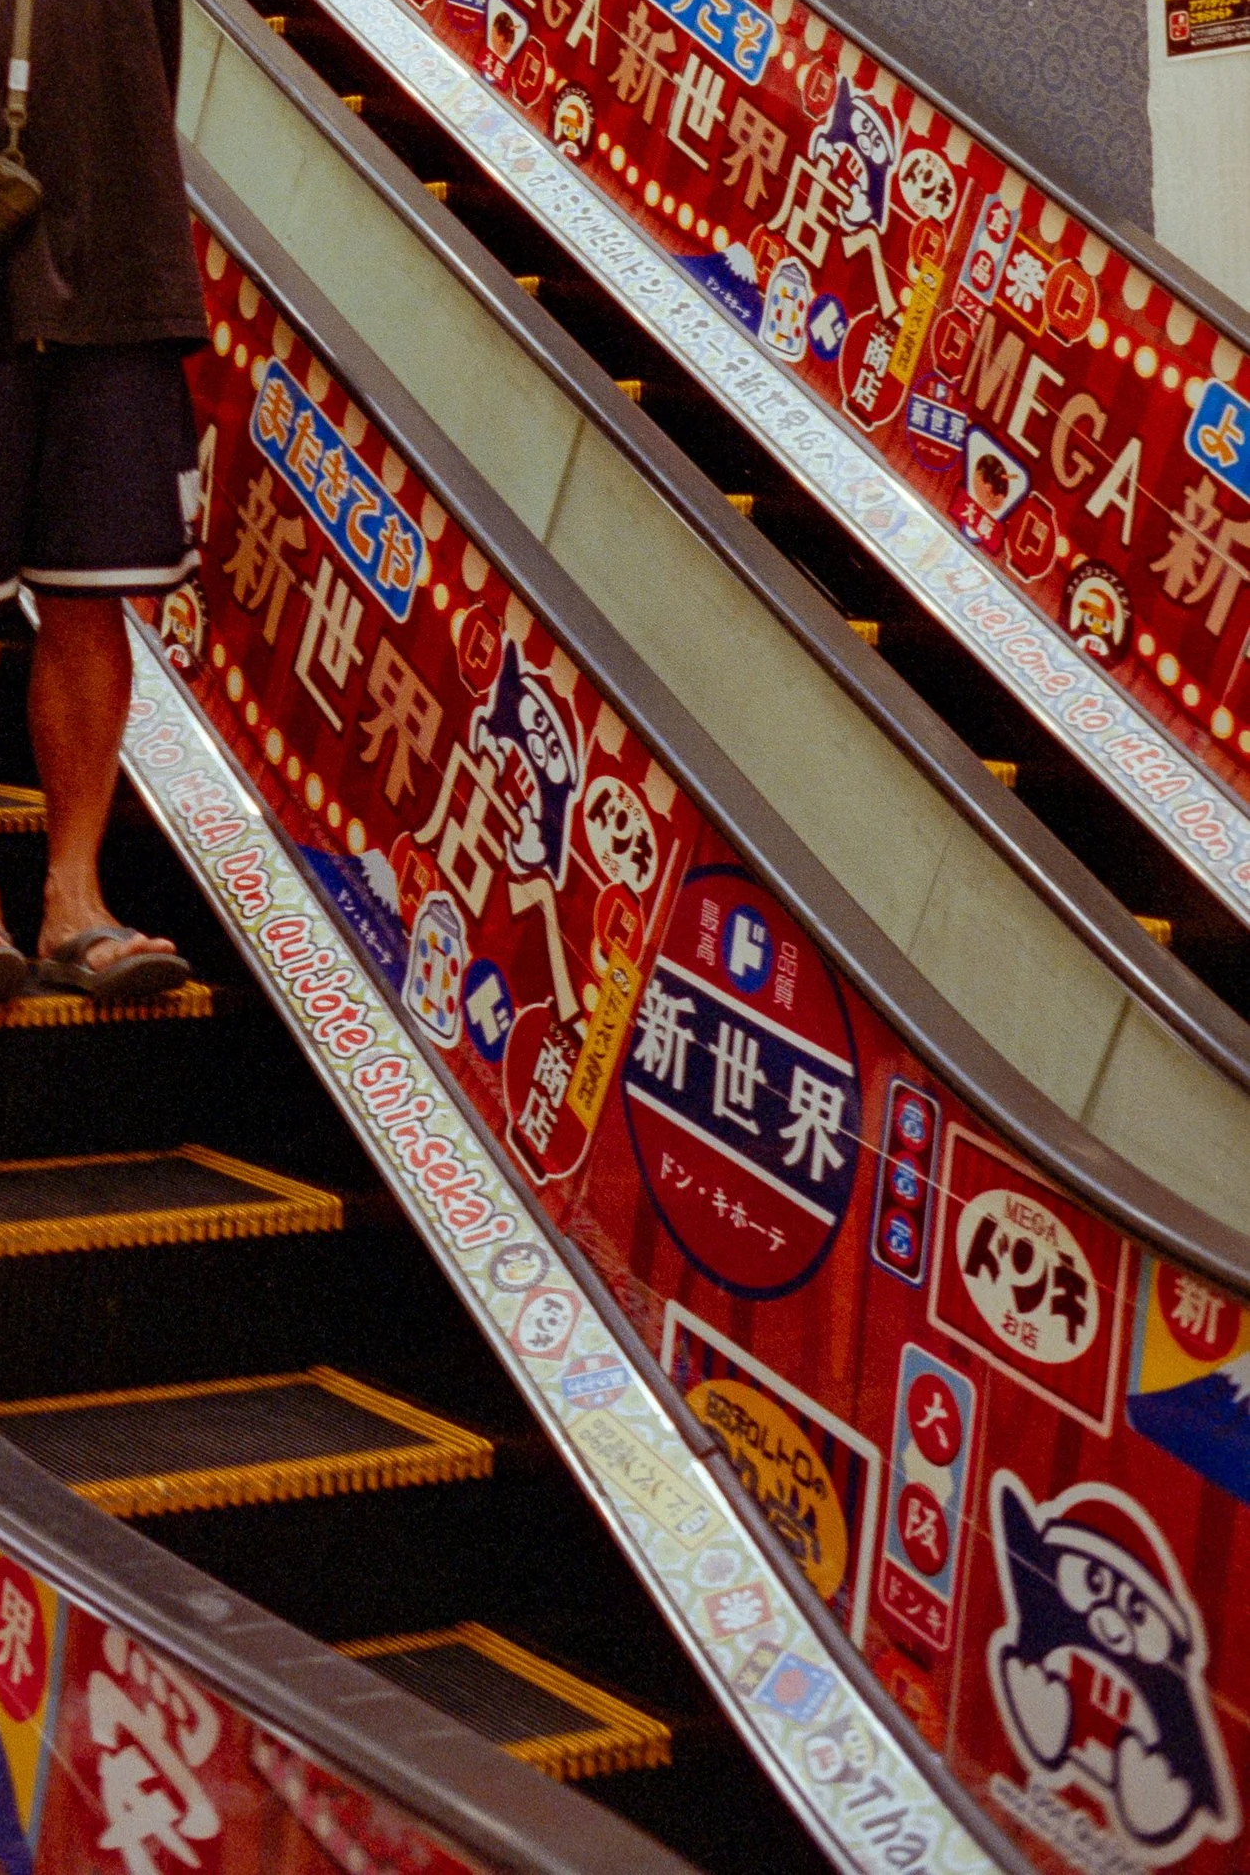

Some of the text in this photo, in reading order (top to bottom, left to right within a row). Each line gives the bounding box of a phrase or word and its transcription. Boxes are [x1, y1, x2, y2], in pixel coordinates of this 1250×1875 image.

[608, 1, 899, 321] 新世界店へ
[970, 201, 1011, 287] 食品
[1007, 253, 1047, 315] 祭
[852, 328, 887, 413] 商店
[908, 399, 965, 451] 新世界
[962, 312, 1143, 548] MEGA
[258, 377, 418, 595] またきてや
[963, 583, 1074, 696] welcome
[1065, 690, 1112, 735] to
[1103, 731, 1192, 803] MEGA
[224, 470, 582, 1023] 新世界店へ
[587, 787, 653, 883] ドンキ
[729, 913, 766, 977] ド
[169, 769, 247, 851] MEGA
[259, 912, 375, 1062] Quijote
[354, 1053, 518, 1252] Shinsekai
[518, 1037, 574, 1155] 商店
[635, 979, 846, 1183] 新世界
[658, 1151, 786, 1252] ドン・キホーテ
[1004, 1195, 1060, 1248] MEGA
[963, 1213, 1089, 1346] ドンキ
[1171, 1274, 1225, 1345] 新
[1002, 1310, 1040, 1351] お店
[904, 1392, 949, 1562] 大阪
[888, 1574, 948, 1633] ドンキ
